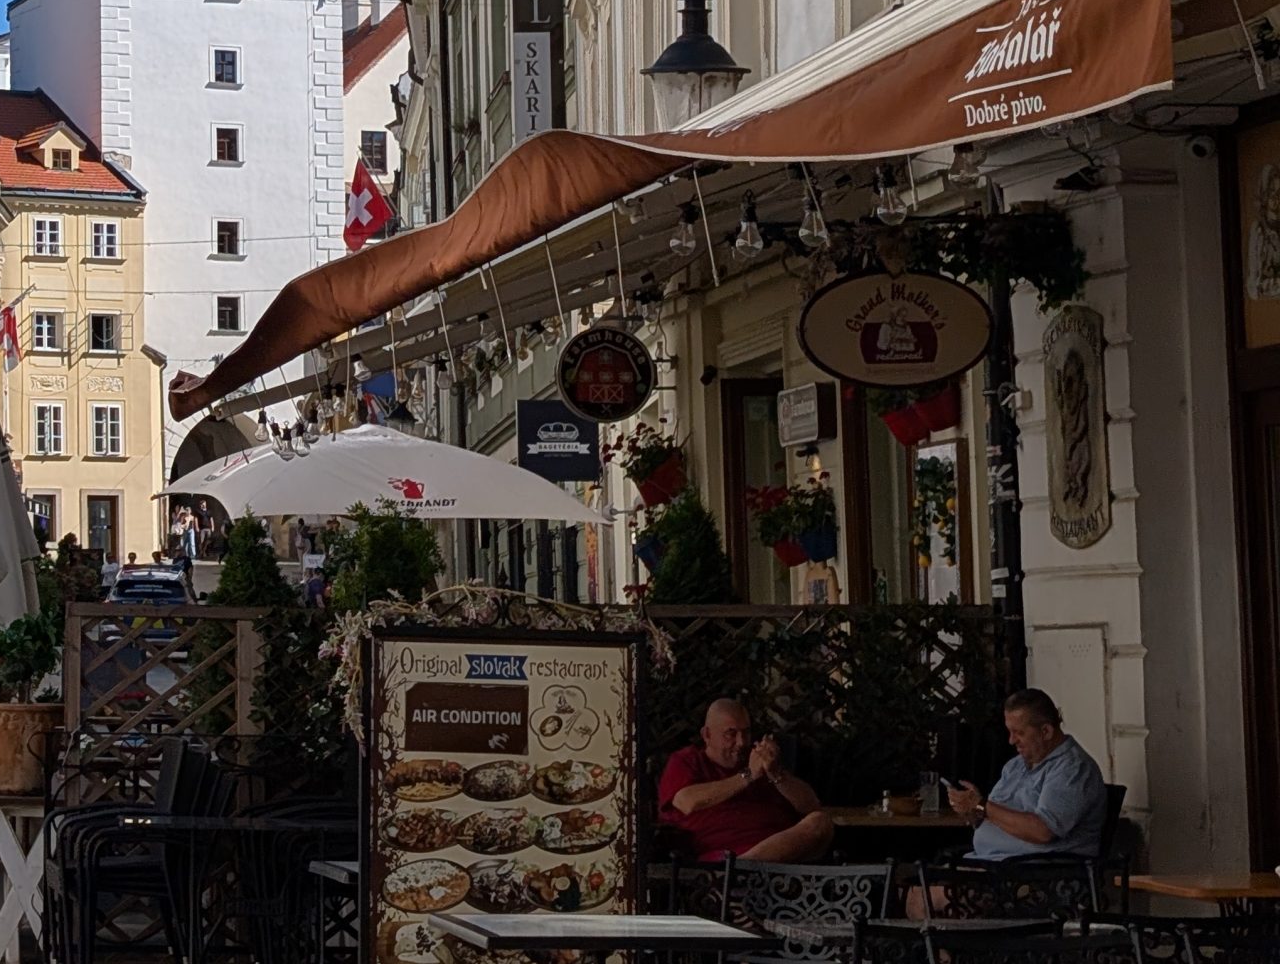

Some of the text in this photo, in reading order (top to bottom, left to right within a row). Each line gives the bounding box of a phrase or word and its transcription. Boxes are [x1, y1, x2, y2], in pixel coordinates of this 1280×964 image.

[524, 41, 540, 136] SKARI
[964, 91, 1046, 127] Dobré pivo.
[399, 646, 608, 679] Original slovak restaurant
[412, 708, 521, 726] AIR CONDITION
